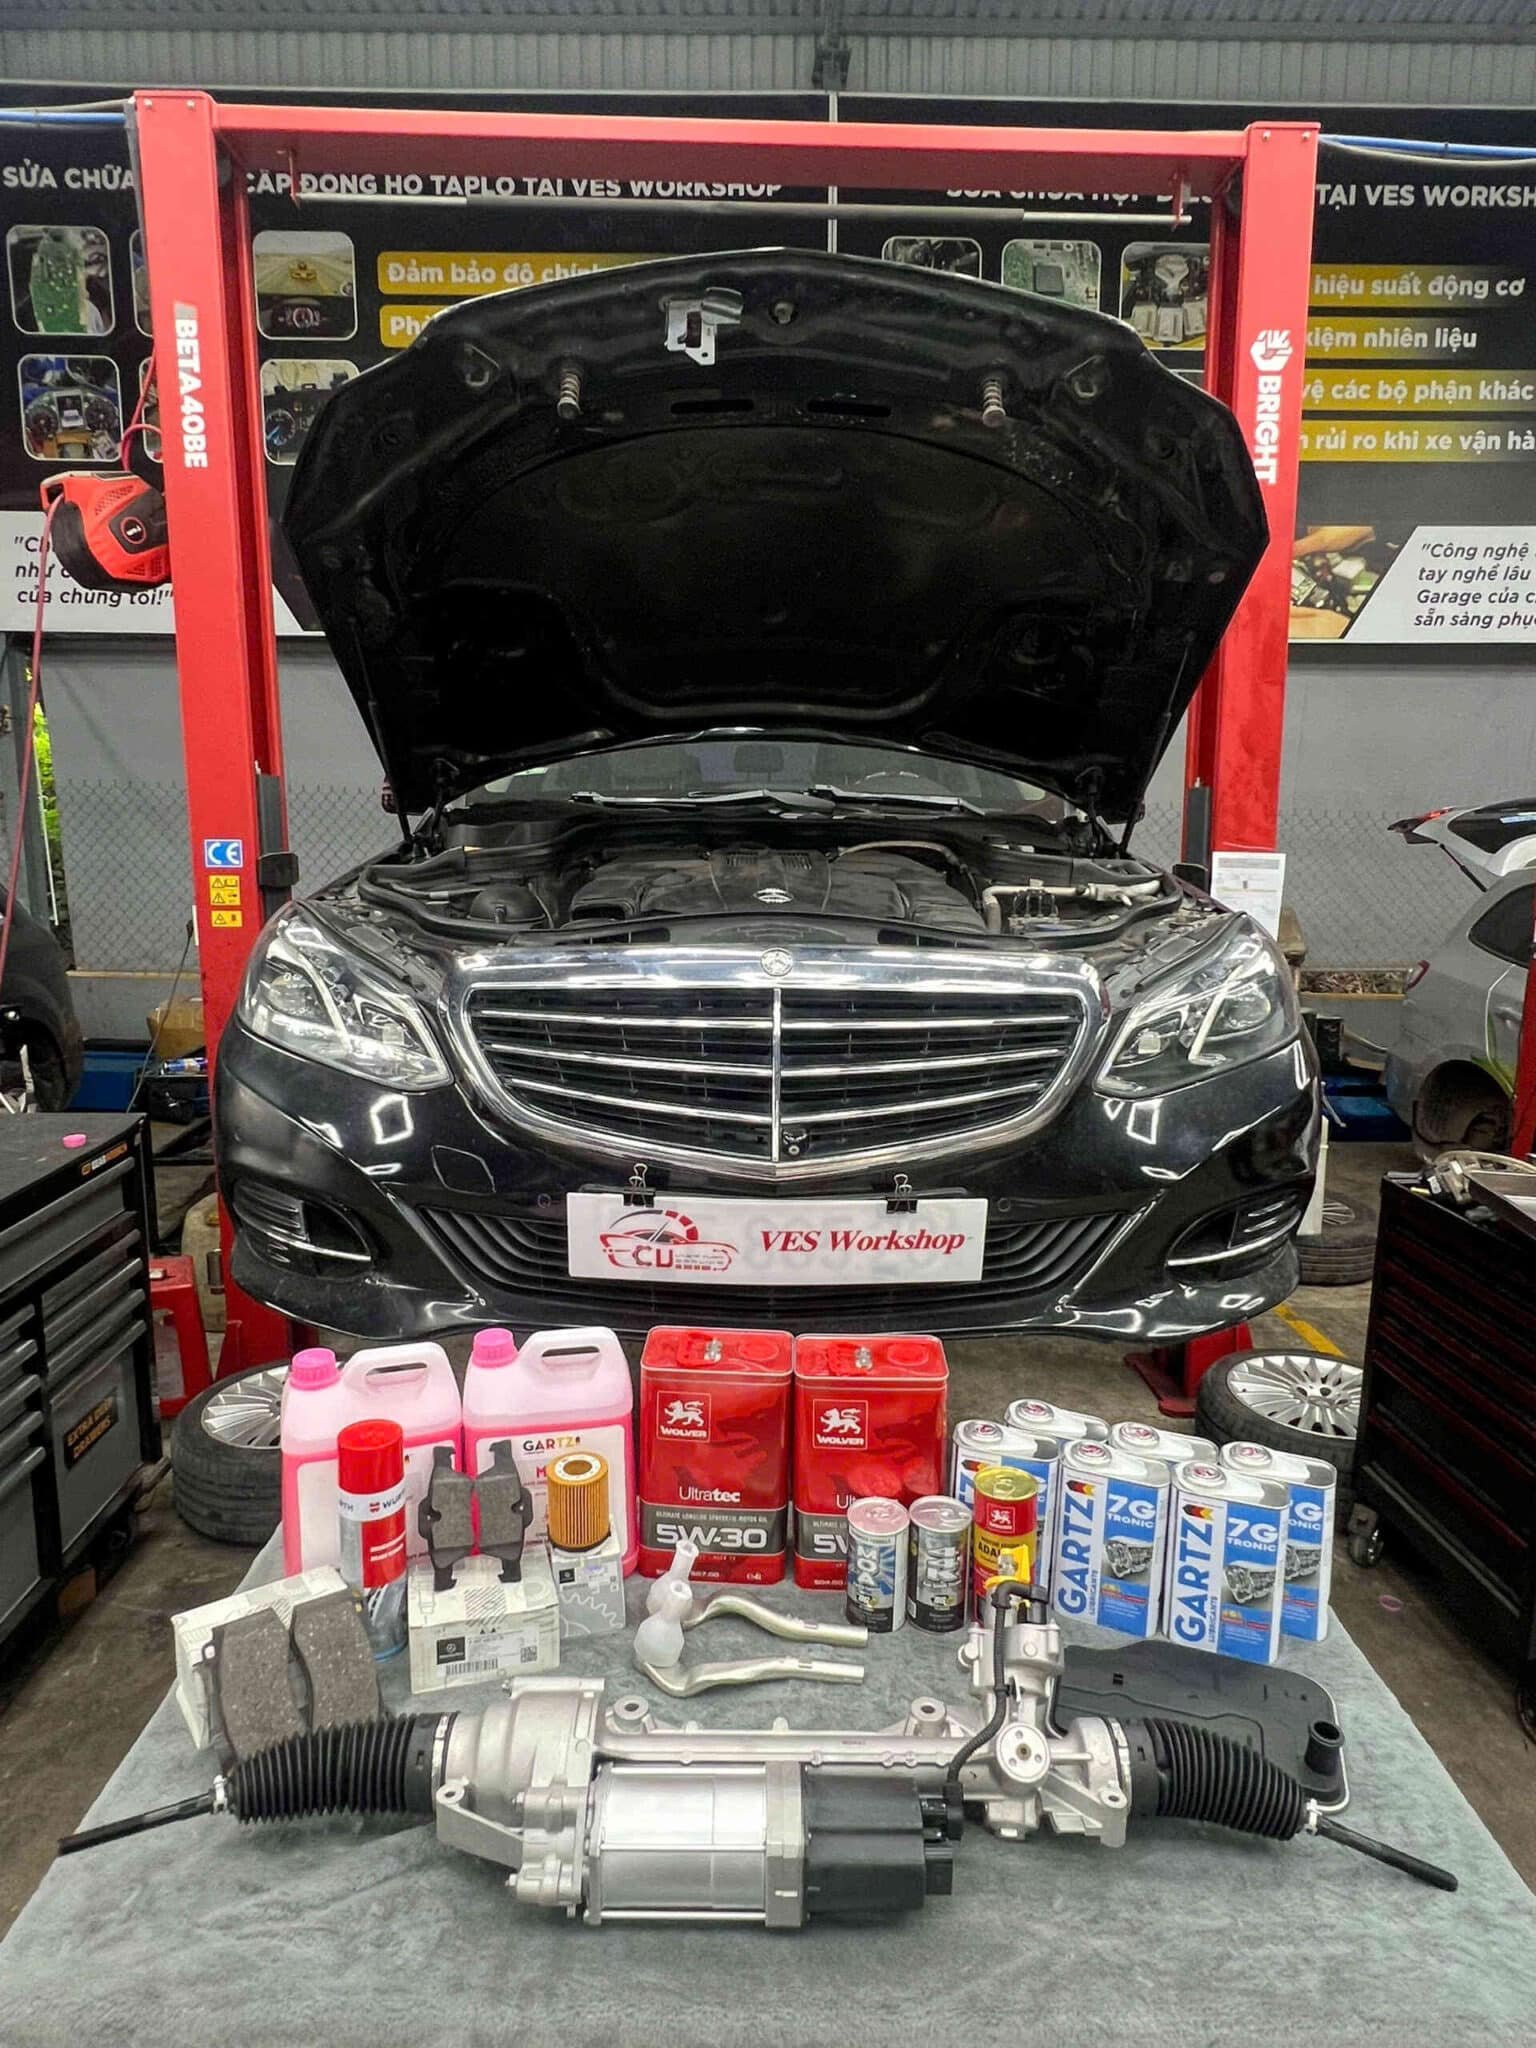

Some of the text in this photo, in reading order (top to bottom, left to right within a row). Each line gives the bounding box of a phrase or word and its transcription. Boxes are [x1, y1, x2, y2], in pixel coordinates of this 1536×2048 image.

[2, 158, 58, 188] SỬA
[570, 178, 622, 198] VES
[1315, 184, 1356, 210] TẠI
[1365, 184, 1415, 207] VES
[387, 258, 443, 283] Đảm
[450, 259, 496, 284] bảo
[1314, 271, 1526, 299] hiệu suất động cơ
[1363, 328, 1429, 349] nhiên
[1434, 327, 1477, 352] liệu
[174, 318, 208, 468] BETA40BE
[1331, 379, 1370, 400] các
[1377, 380, 1409, 404] bộ
[1414, 380, 1472, 404] phận
[1479, 379, 1535, 401] khác
[1253, 375, 1282, 484] BRIGHT
[1315, 426, 1346, 449] rủi
[1352, 433, 1377, 450] ro
[1383, 431, 1419, 450] khi
[1425, 434, 1452, 450] xe
[1459, 429, 1501, 455] vận
[1421, 542, 1530, 561] "Công nghệ
[1418, 567, 1448, 583] tay
[1503, 566, 1532, 581] lâu
[1417, 589, 1482, 606] Garage
[1488, 586, 1519, 604] của
[760, 1228, 965, 1255] VES Workshop
[523, 1437, 574, 1452] GARTZ
[659, 1425, 707, 1438] WOLVER
[816, 1433, 865, 1445] WOLVER
[679, 1486, 741, 1503] Ultratec
[1108, 1494, 1156, 1520] 7G
[1107, 1513, 1154, 1529] TRONIC
[1227, 1517, 1279, 1543] 7G
[656, 1523, 768, 1549] 5W-30
[1226, 1536, 1278, 1552] TRONIC
[1058, 1493, 1094, 1615] GARTZ
[1174, 1516, 1213, 1643] GARTZ
